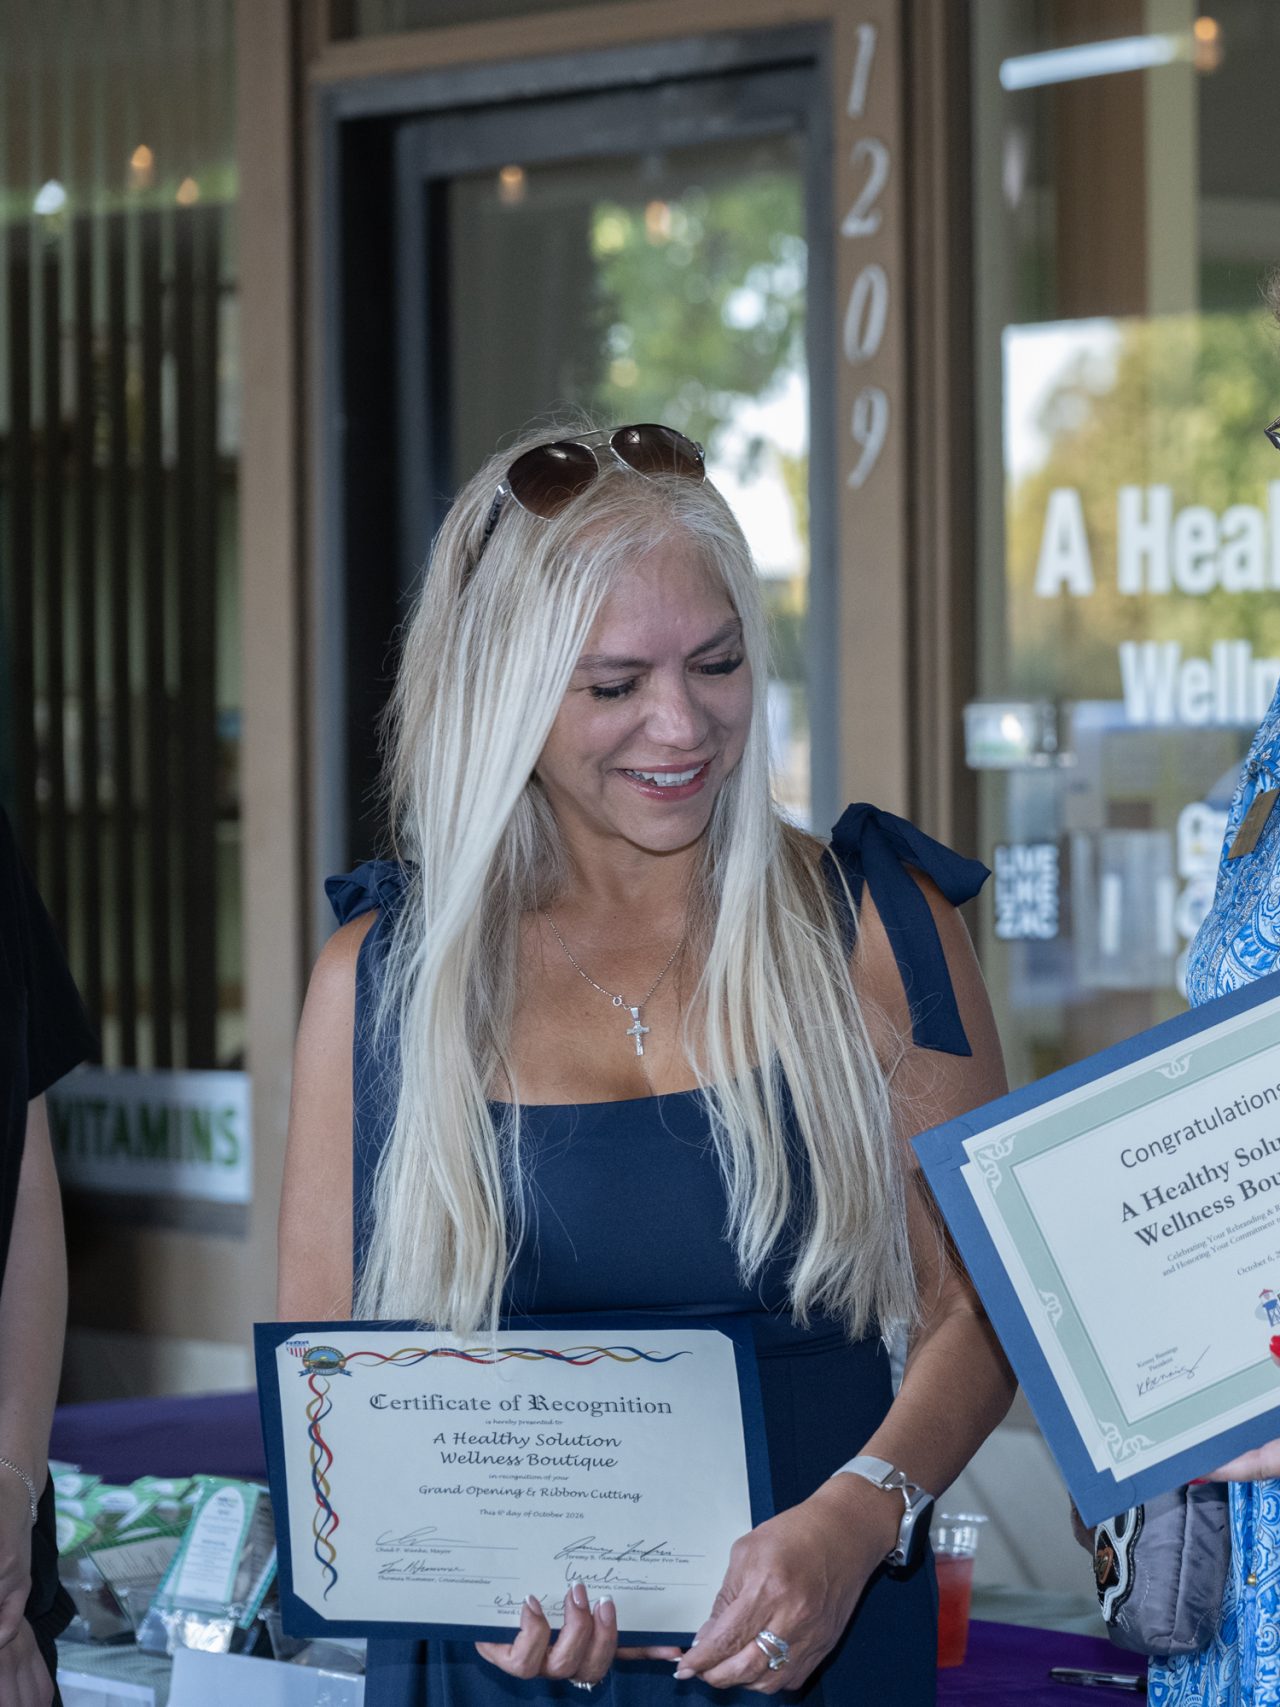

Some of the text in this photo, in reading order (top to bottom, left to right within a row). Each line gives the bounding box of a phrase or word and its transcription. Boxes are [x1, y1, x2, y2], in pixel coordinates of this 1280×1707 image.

[1034, 487, 1095, 597] A
[1121, 1199, 1139, 1223] A
[1140, 1159, 1230, 1211] Healthy
[1134, 1195, 1235, 1248] Wellness
[1162, 1265, 1176, 1277] and
[1176, 1250, 1211, 1270] Honoring
[1210, 1242, 1229, 1254] Your
[1229, 1220, 1276, 1245] Commitment
[1167, 1239, 1206, 1262] Celebrating
[1207, 1231, 1226, 1244] Your
[1226, 1213, 1267, 1235] Rebranding
[1237, 1258, 1267, 1276] October
[369, 1393, 672, 1417] Certificate of Recognition
[433, 1431, 622, 1449] A Healthy Solution
[440, 1451, 618, 1472] Wellness Boutique
[419, 1484, 643, 1503] Grand Opening & Ribbon Cutting
[533, 1510, 564, 1518] October
